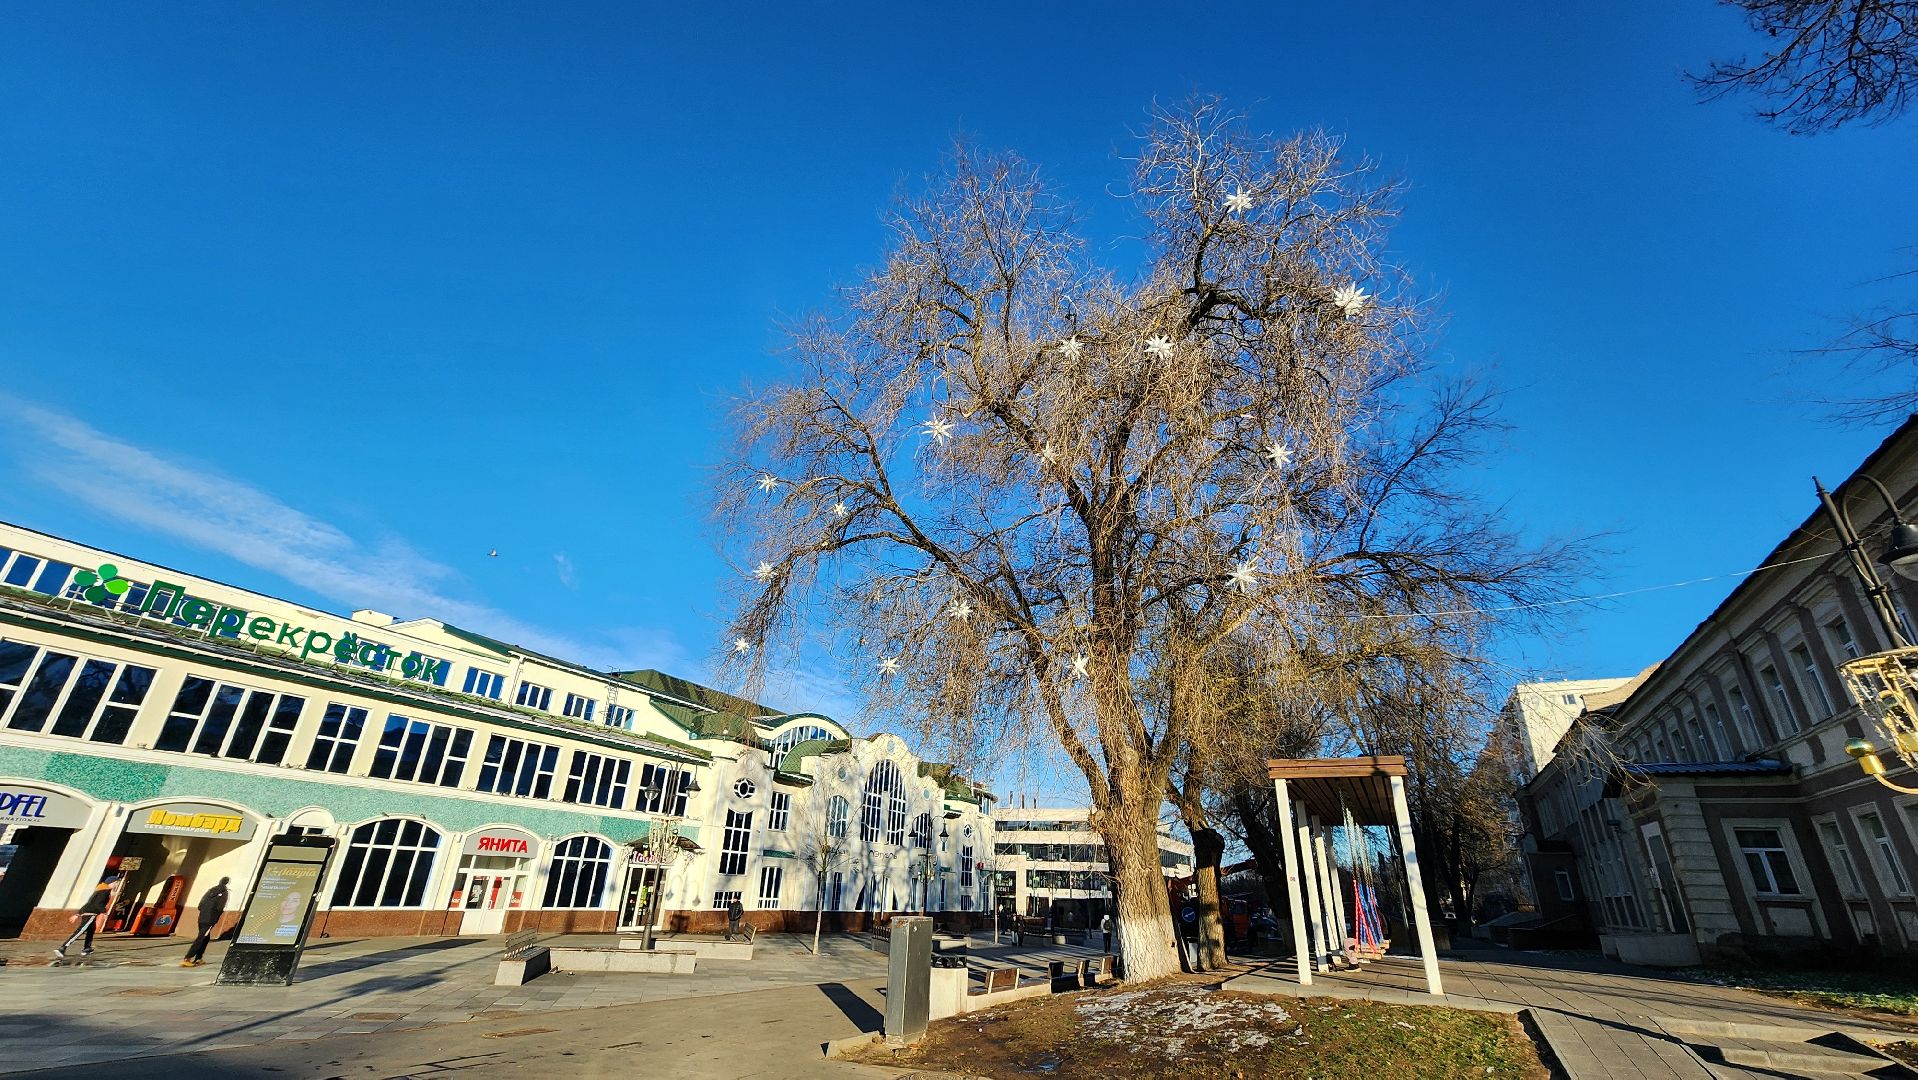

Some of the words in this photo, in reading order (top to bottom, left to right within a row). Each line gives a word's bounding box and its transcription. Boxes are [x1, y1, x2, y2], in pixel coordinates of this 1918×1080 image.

[140, 580, 445, 684] Перекрёсток
[146, 810, 244, 833] Ломбард
[477, 836, 528, 853] ЯНИТА
